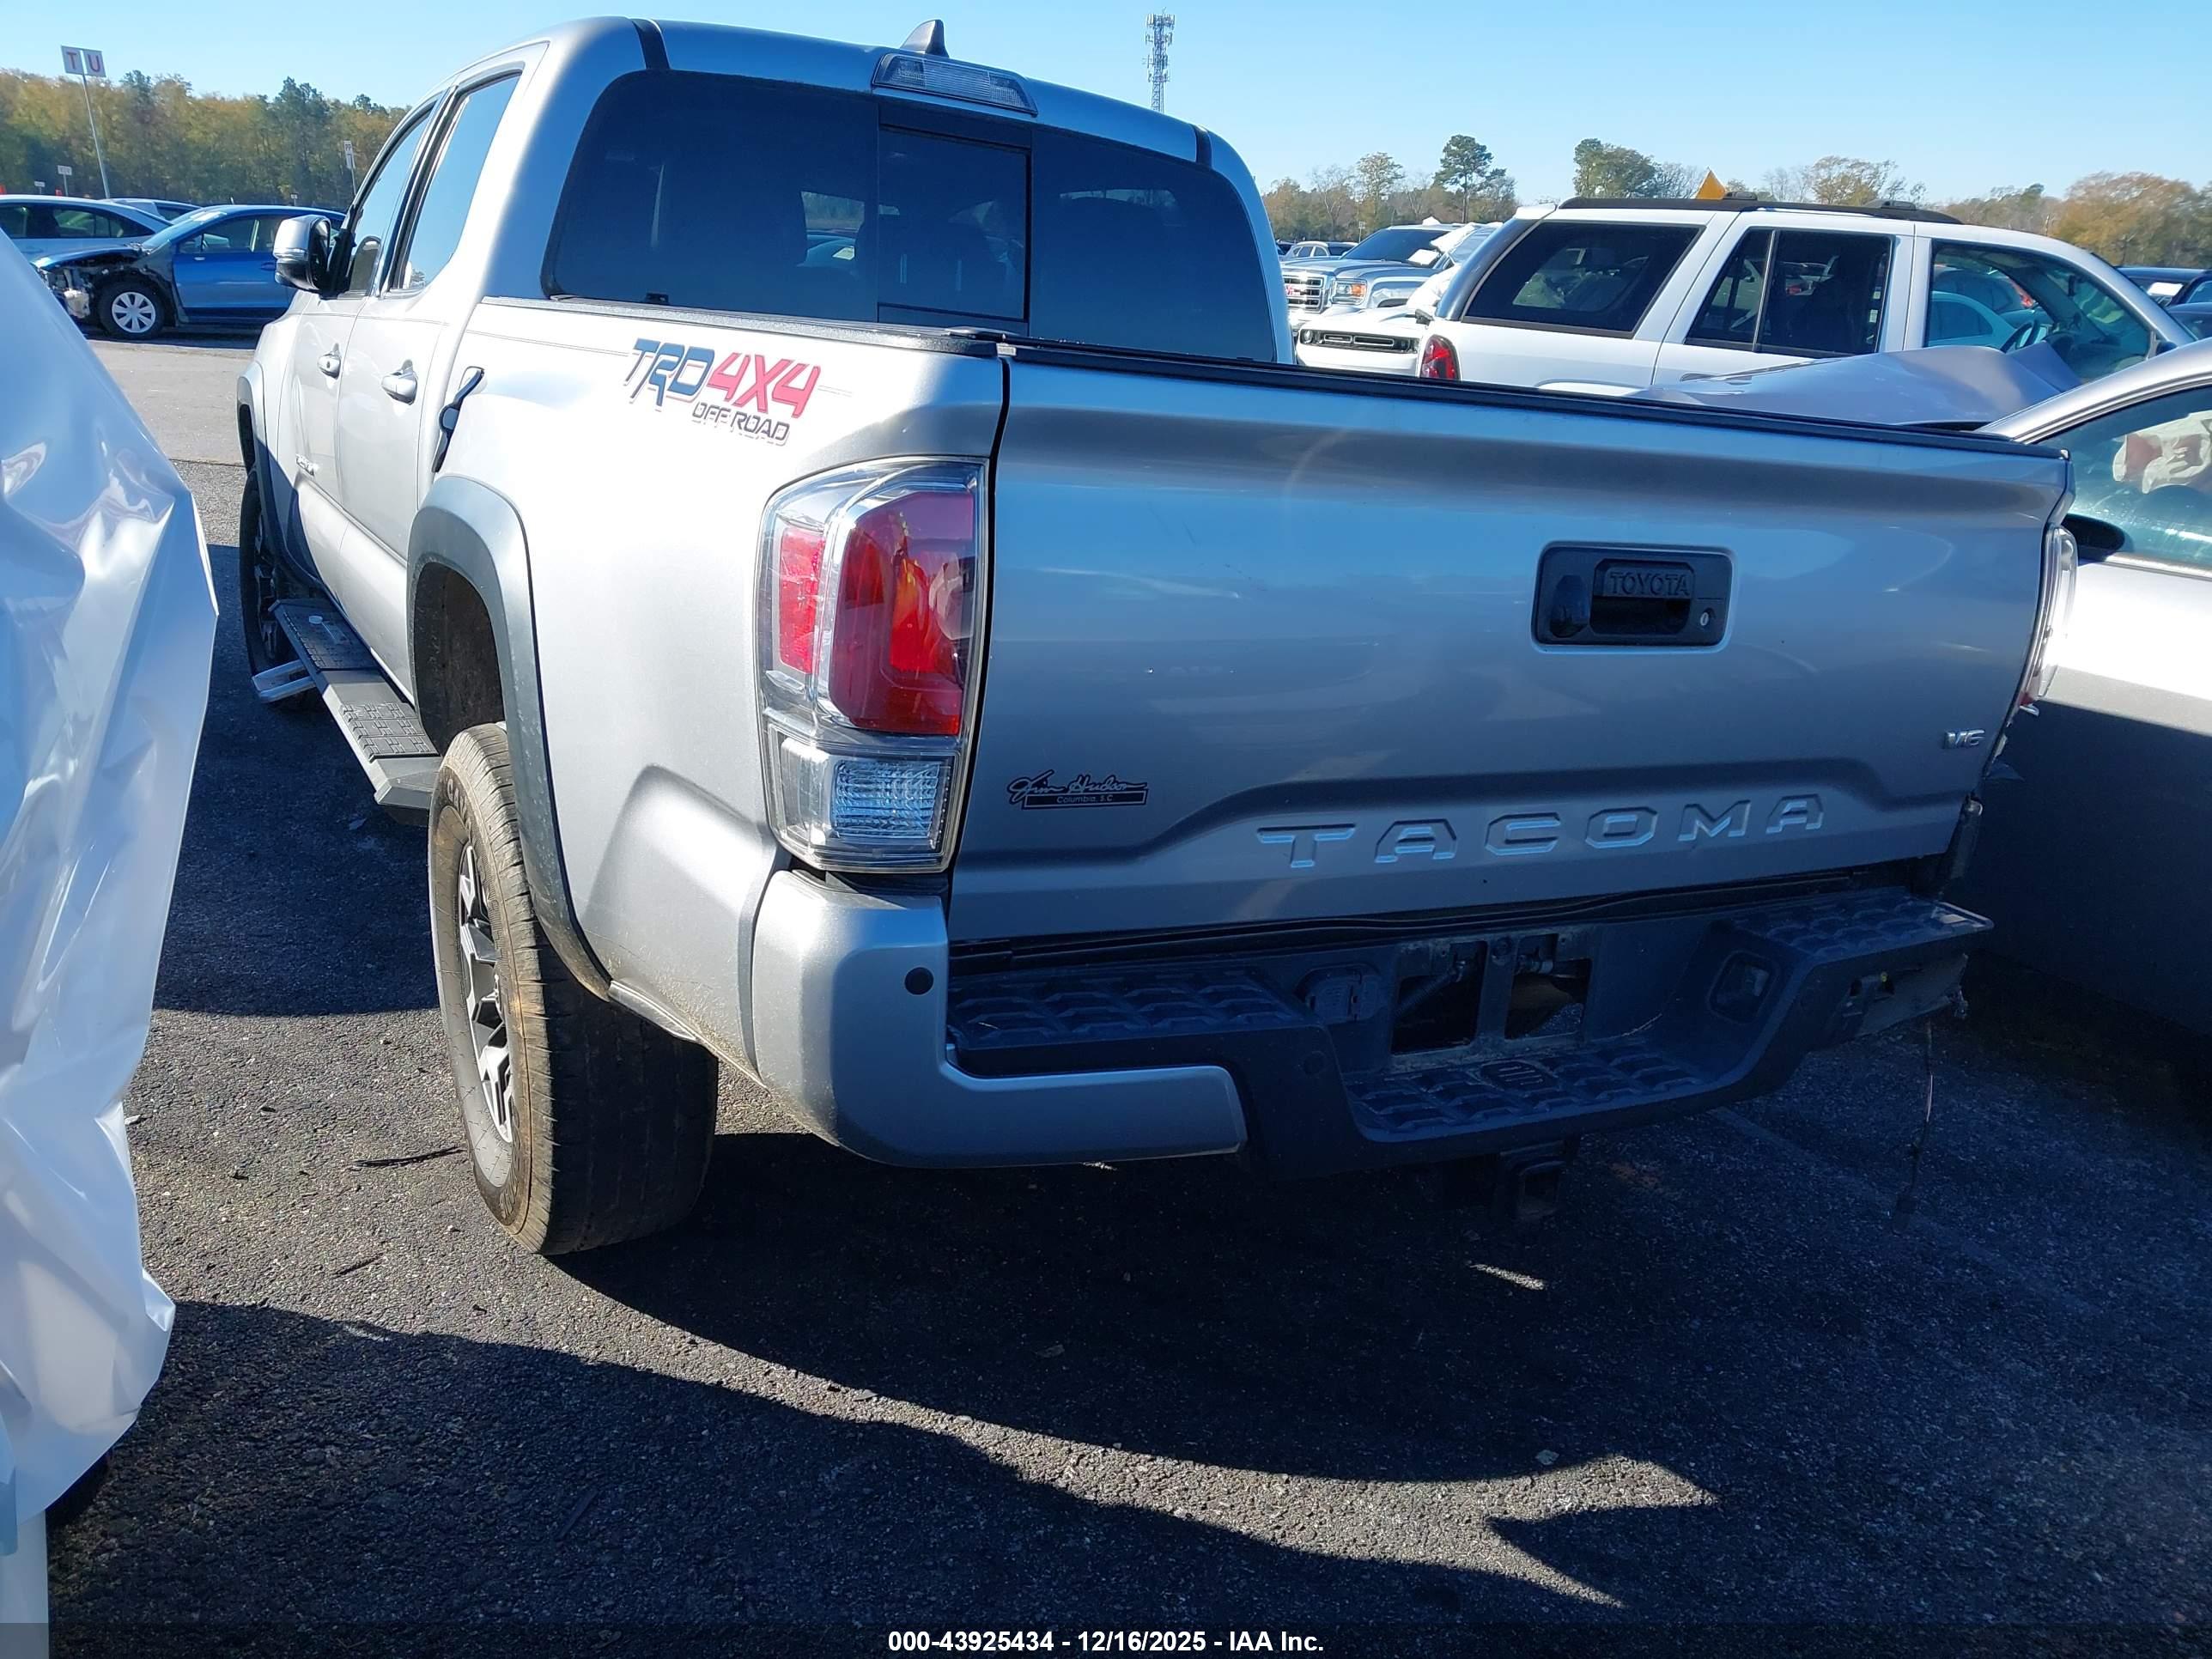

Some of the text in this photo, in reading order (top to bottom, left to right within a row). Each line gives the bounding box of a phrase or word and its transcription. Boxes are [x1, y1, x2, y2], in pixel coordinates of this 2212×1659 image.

[66, 52, 101, 72] T U
[624, 337, 821, 419] TRD 4X4
[692, 402, 791, 441] OFF ROAD
[1609, 572, 1691, 596] TOYOTA
[1945, 729, 1985, 748] V6
[1256, 793, 1825, 867] TACOMA
